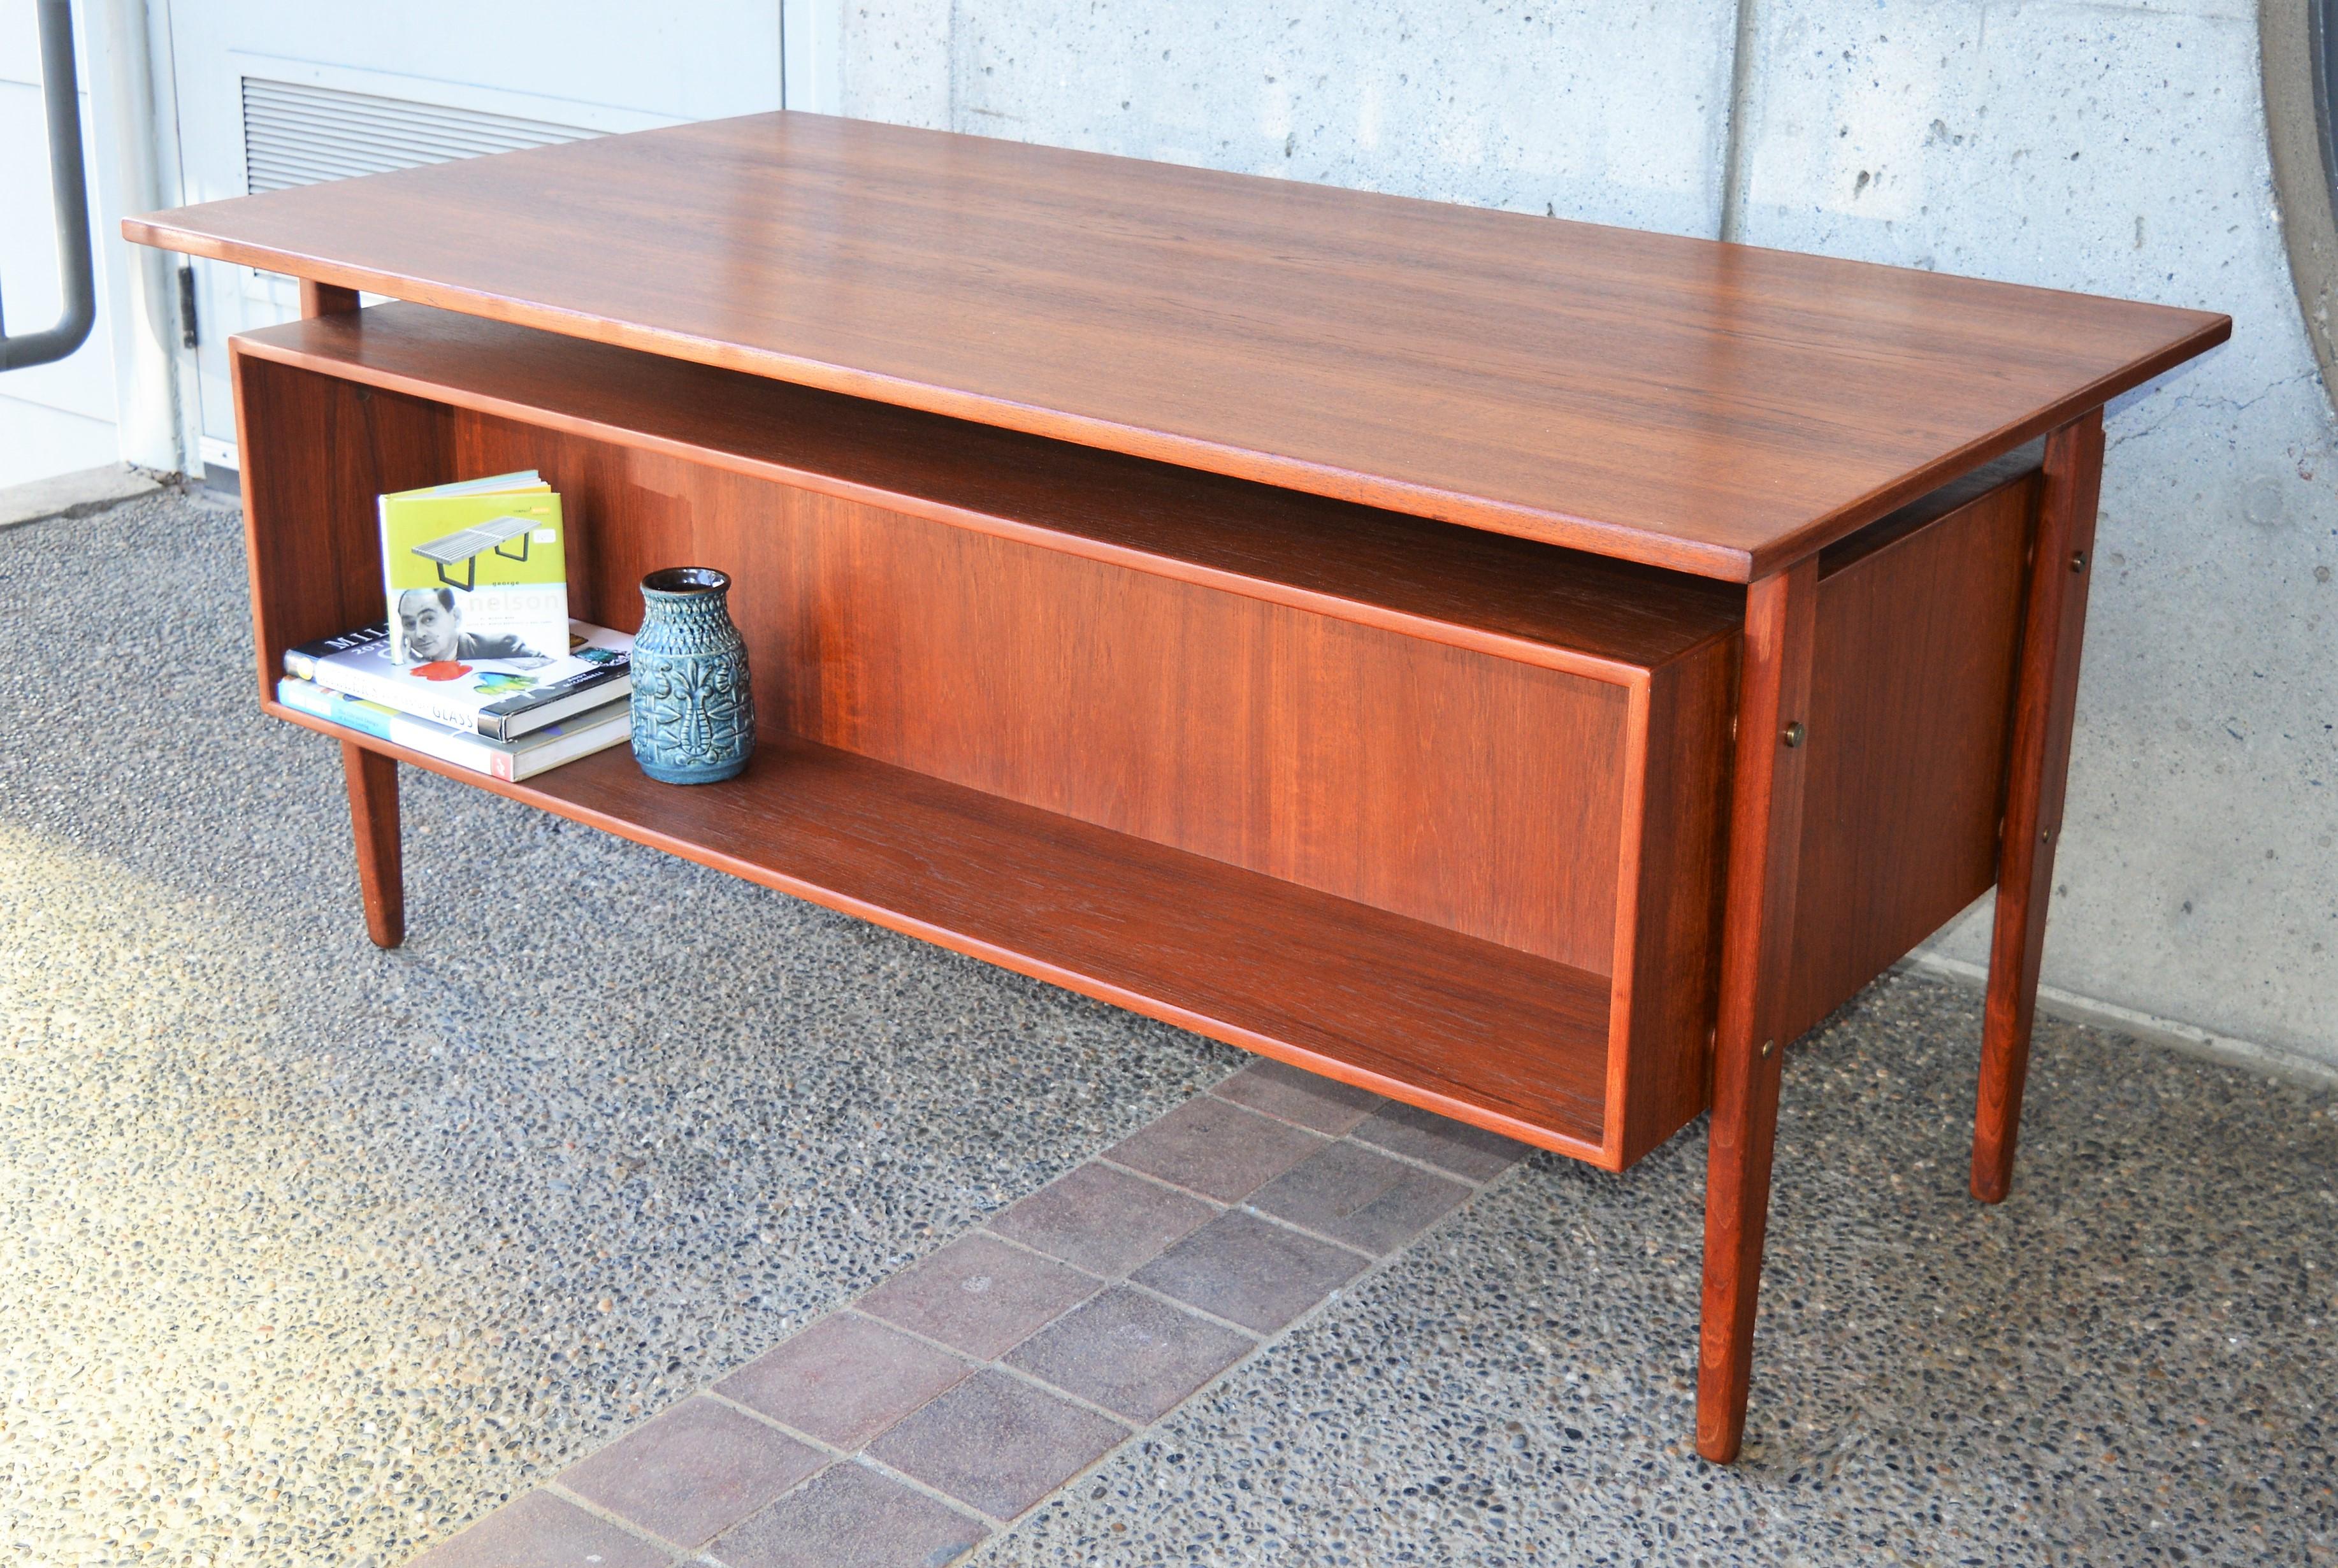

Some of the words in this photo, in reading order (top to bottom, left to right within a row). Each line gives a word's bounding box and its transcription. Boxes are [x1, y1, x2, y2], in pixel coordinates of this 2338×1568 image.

[469, 591, 559, 612] nelson
[324, 622, 390, 649] MIL
[433, 707, 472, 728] GLASS
